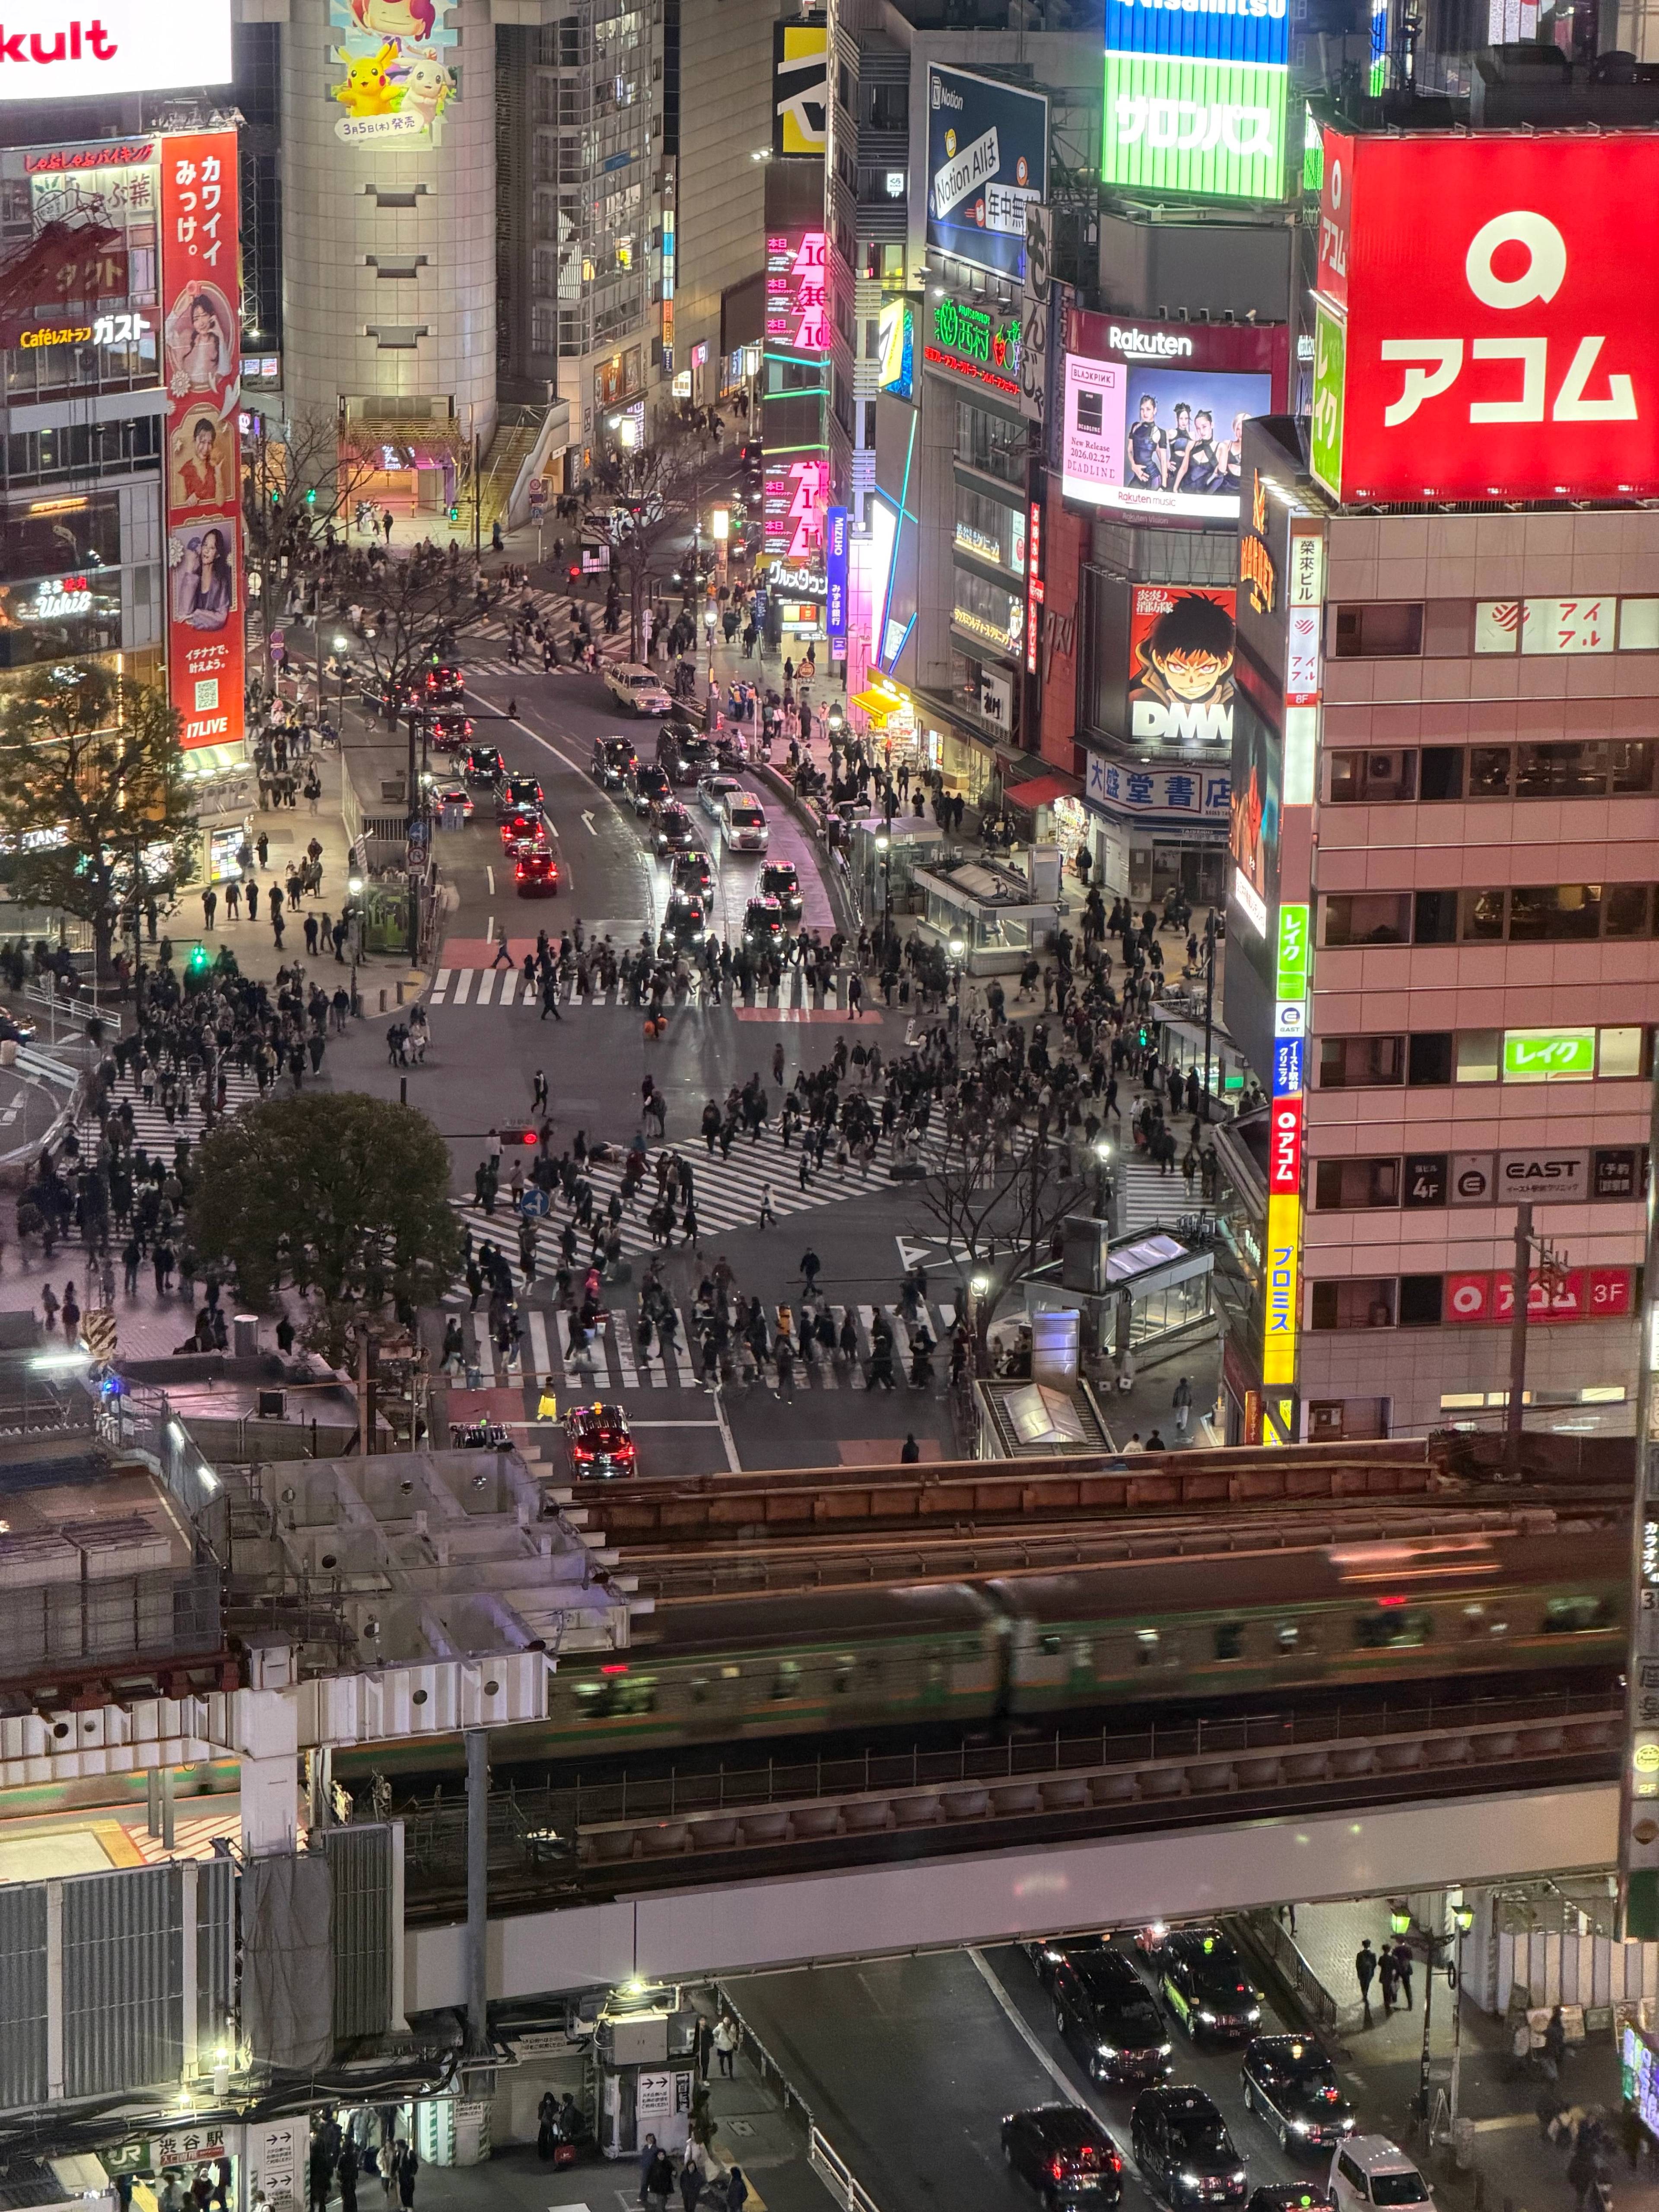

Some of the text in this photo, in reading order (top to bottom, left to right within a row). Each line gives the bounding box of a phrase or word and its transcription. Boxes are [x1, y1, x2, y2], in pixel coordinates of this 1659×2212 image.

[941, 87, 963, 111] Notion
[1115, 94, 1273, 158] サロンパス
[25, 143, 155, 172] しゃぶしゃぶバイキング
[937, 165, 969, 208] Notion
[201, 156, 222, 266] カワイイ
[769, 238, 787, 248] 本日
[1322, 218, 1346, 277] アコム
[768, 279, 786, 288] 本日
[94, 313, 150, 345] ガスト
[768, 319, 786, 328] 本日
[958, 319, 989, 361] 西村
[1110, 327, 1192, 356] Rakuten
[1074, 369, 1111, 384] BLACKPINK
[1315, 322, 1337, 449] レイク
[1381, 337, 1638, 427] アコム
[1078, 423, 1100, 433] DEADLINE
[1071, 437, 1110, 452] New Release
[1071, 448, 1110, 464] 2026.02.27
[1068, 459, 1115, 479] DEADLINE
[766, 481, 784, 491] 本日
[1119, 491, 1176, 506] Rakuten music
[765, 521, 784, 530] 本日
[1123, 512, 1147, 522] Rakuten
[834, 517, 844, 556] MIZUHO
[770, 560, 828, 595] グルメタウン
[832, 585, 841, 626] みずほ銀行
[1138, 589, 1168, 601] 炎炎ノ
[1136, 601, 1174, 613] 消防隊
[186, 645, 229, 661] イチナナで、
[189, 659, 226, 674] 叶えよう。
[1296, 694, 1308, 704] 8F
[187, 717, 228, 738] 17LIVE
[1091, 760, 1231, 807] 大盛堂書店
[1283, 914, 1301, 961] レイク
[1516, 1042, 1578, 1065] レイク
[1279, 1047, 1288, 1085] クリニック
[1289, 1041, 1299, 1090] イースト駅前
[1275, 1132, 1294, 1180] アコム
[1506, 1161, 1581, 1179] EAST
[1413, 1177, 1439, 1199] 4F
[1271, 1245, 1294, 1331] プロミス
[1593, 1283, 1624, 1303] 3F
[1643, 1522, 1659, 1574] カラオケ
[1639, 1784, 1657, 1793] 2F
[159, 2129, 224, 2155] 渋谷駅
[111, 2145, 141, 2165] JR
[161, 2152, 197, 2165] 入口専用
